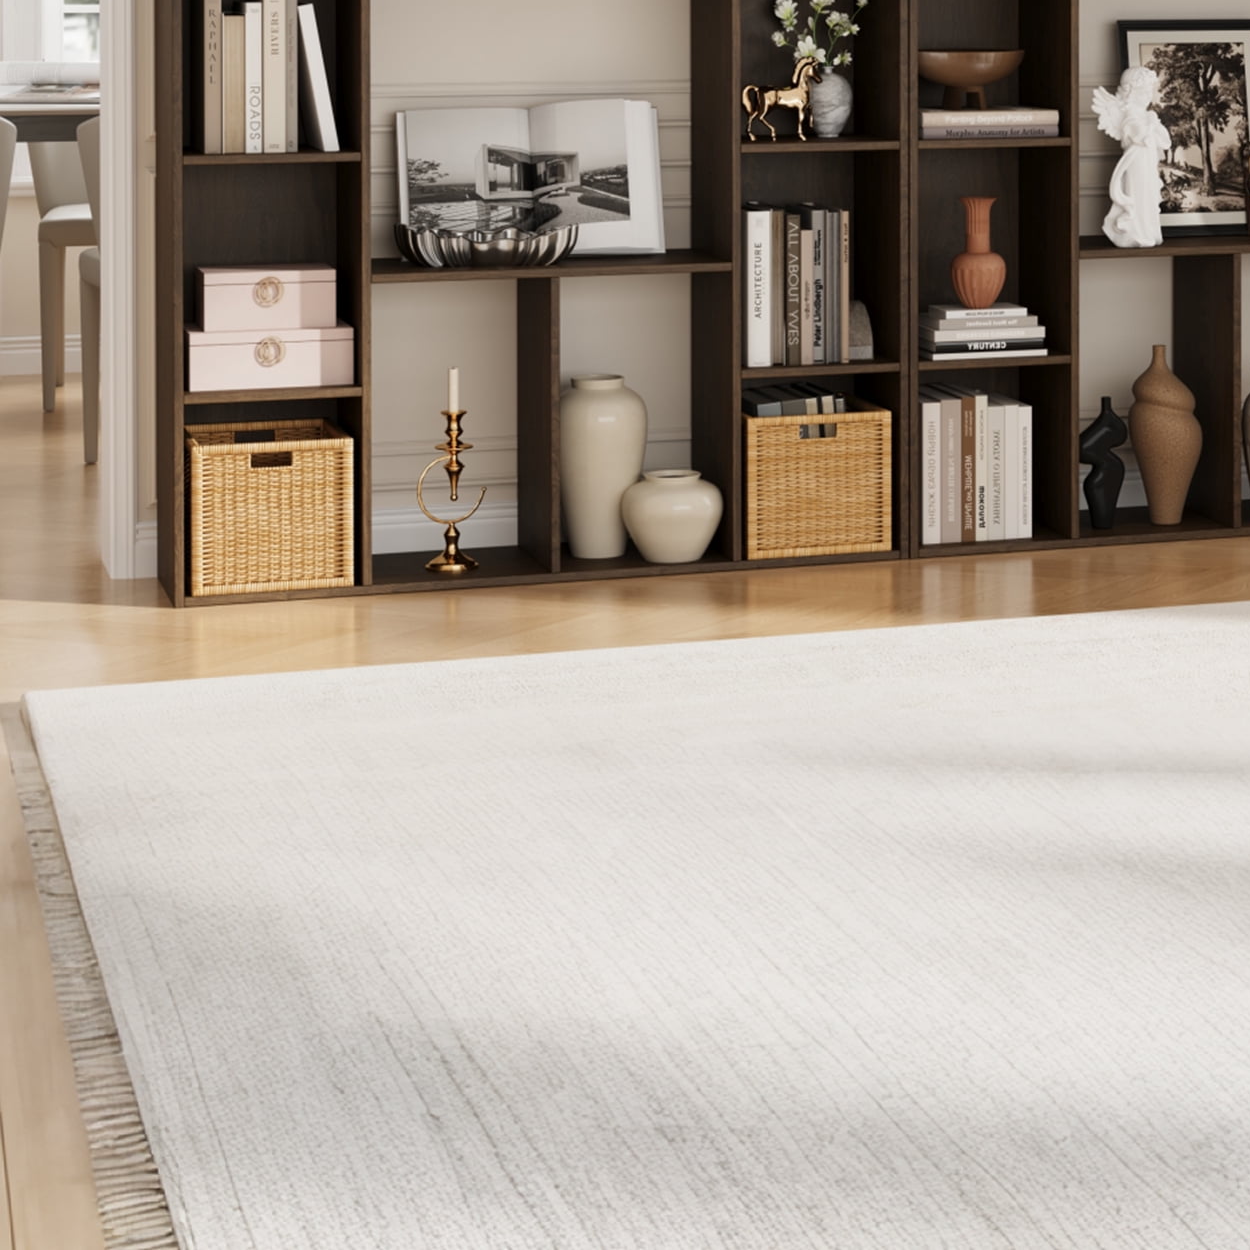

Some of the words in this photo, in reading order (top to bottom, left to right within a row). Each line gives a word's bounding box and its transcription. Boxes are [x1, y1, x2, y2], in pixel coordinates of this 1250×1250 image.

[270, 11, 279, 56] RIVERS
[250, 85, 261, 141] ROADS
[788, 221, 799, 248] ALL
[754, 242, 763, 319] ARCHITECTURE
[788, 253, 799, 303] ABOUT
[814, 278, 824, 323] Lindbergh
[788, 310, 799, 346] YVES
[814, 323, 822, 347] Peter
